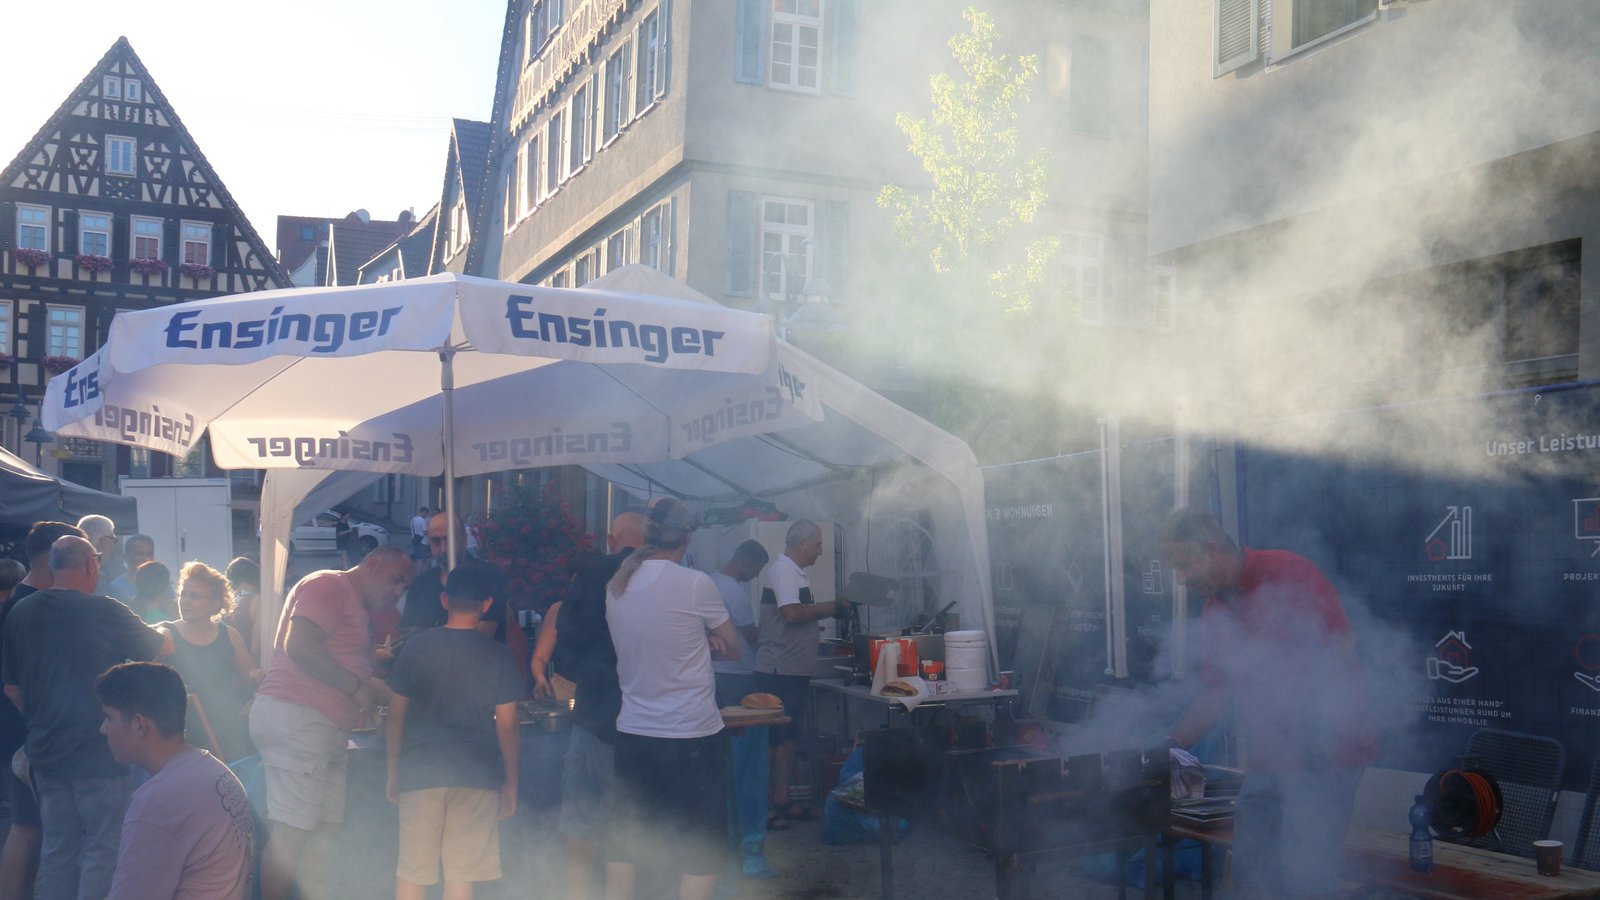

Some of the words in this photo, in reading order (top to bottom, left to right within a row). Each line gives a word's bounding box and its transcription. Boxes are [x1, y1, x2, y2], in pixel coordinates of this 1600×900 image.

[163, 305, 403, 353] Ensinger
[505, 294, 725, 364] Ensinger
[64, 357, 100, 409] Ens
[1486, 440, 1535, 457] Unser
[1003, 503, 1053, 519] WOHNUNGEN
[1407, 574, 1456, 582] INVESTMENTS
[1457, 572, 1472, 582] FÜR
[1474, 573, 1493, 582] IHRE
[1432, 584, 1466, 592] ZUKUNFT
[1437, 697, 1451, 705] AUS
[1453, 698, 1476, 706] EINER
[1477, 708, 1499, 717] RUND
[1500, 711, 1512, 719] UM
[1428, 715, 1446, 723] IHRE
[1447, 716, 1488, 726] IMMOBILIE
